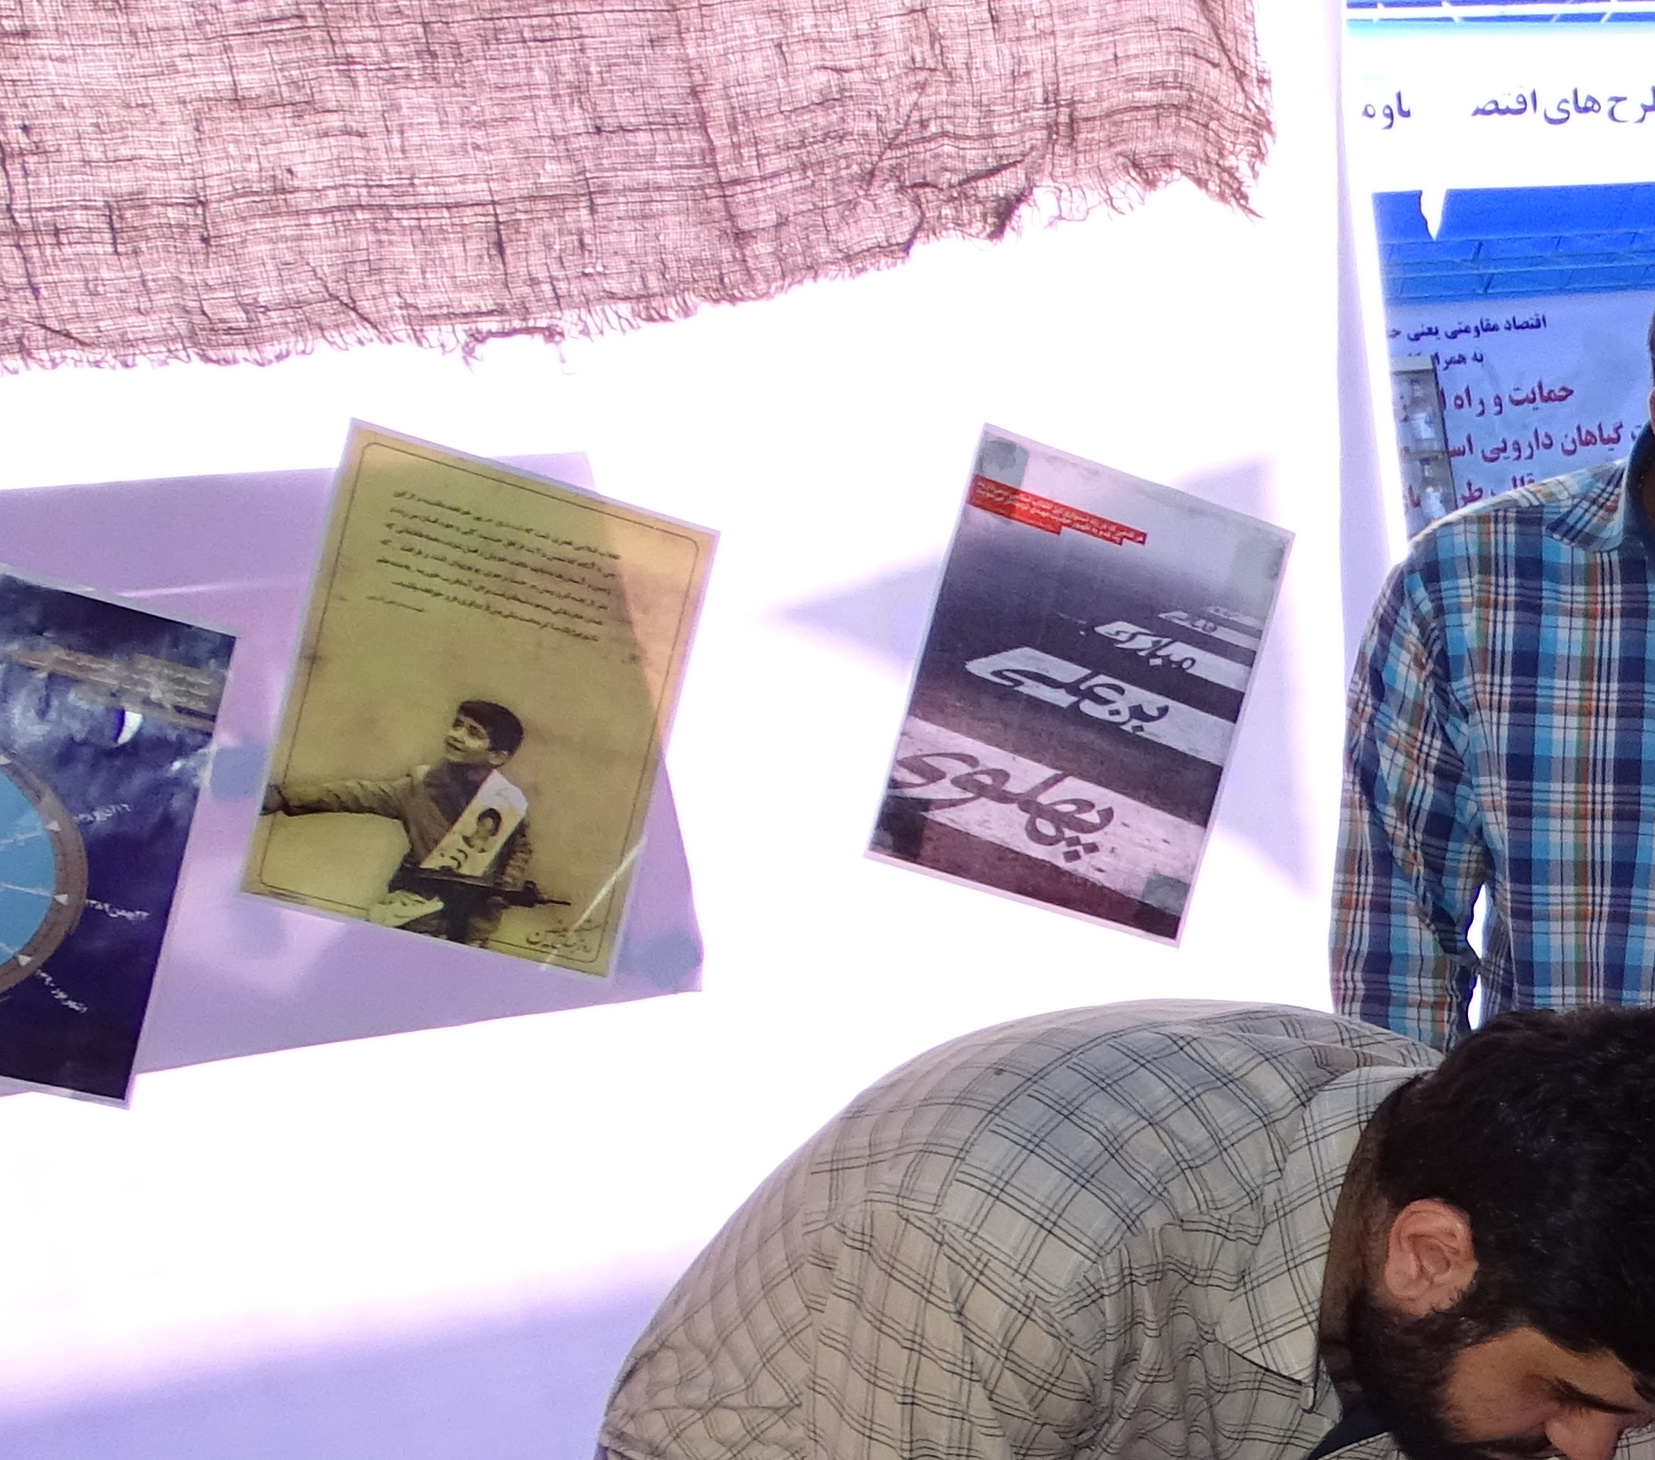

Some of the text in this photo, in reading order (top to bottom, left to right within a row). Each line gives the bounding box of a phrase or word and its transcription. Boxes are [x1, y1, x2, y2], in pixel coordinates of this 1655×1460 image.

[1406, 324, 1441, 342] یعنی
[1444, 316, 1500, 340] مقاومتی
[1503, 312, 1548, 332] اقتصاد
[1433, 351, 1468, 372] همرا
[1453, 384, 1487, 418] راه
[1493, 392, 1504, 415] و
[1507, 379, 1575, 412] حمایت
[1480, 426, 1554, 463] دارویی
[1560, 420, 1625, 457] گیاهان
[887, 750, 1115, 863] پهلوی
